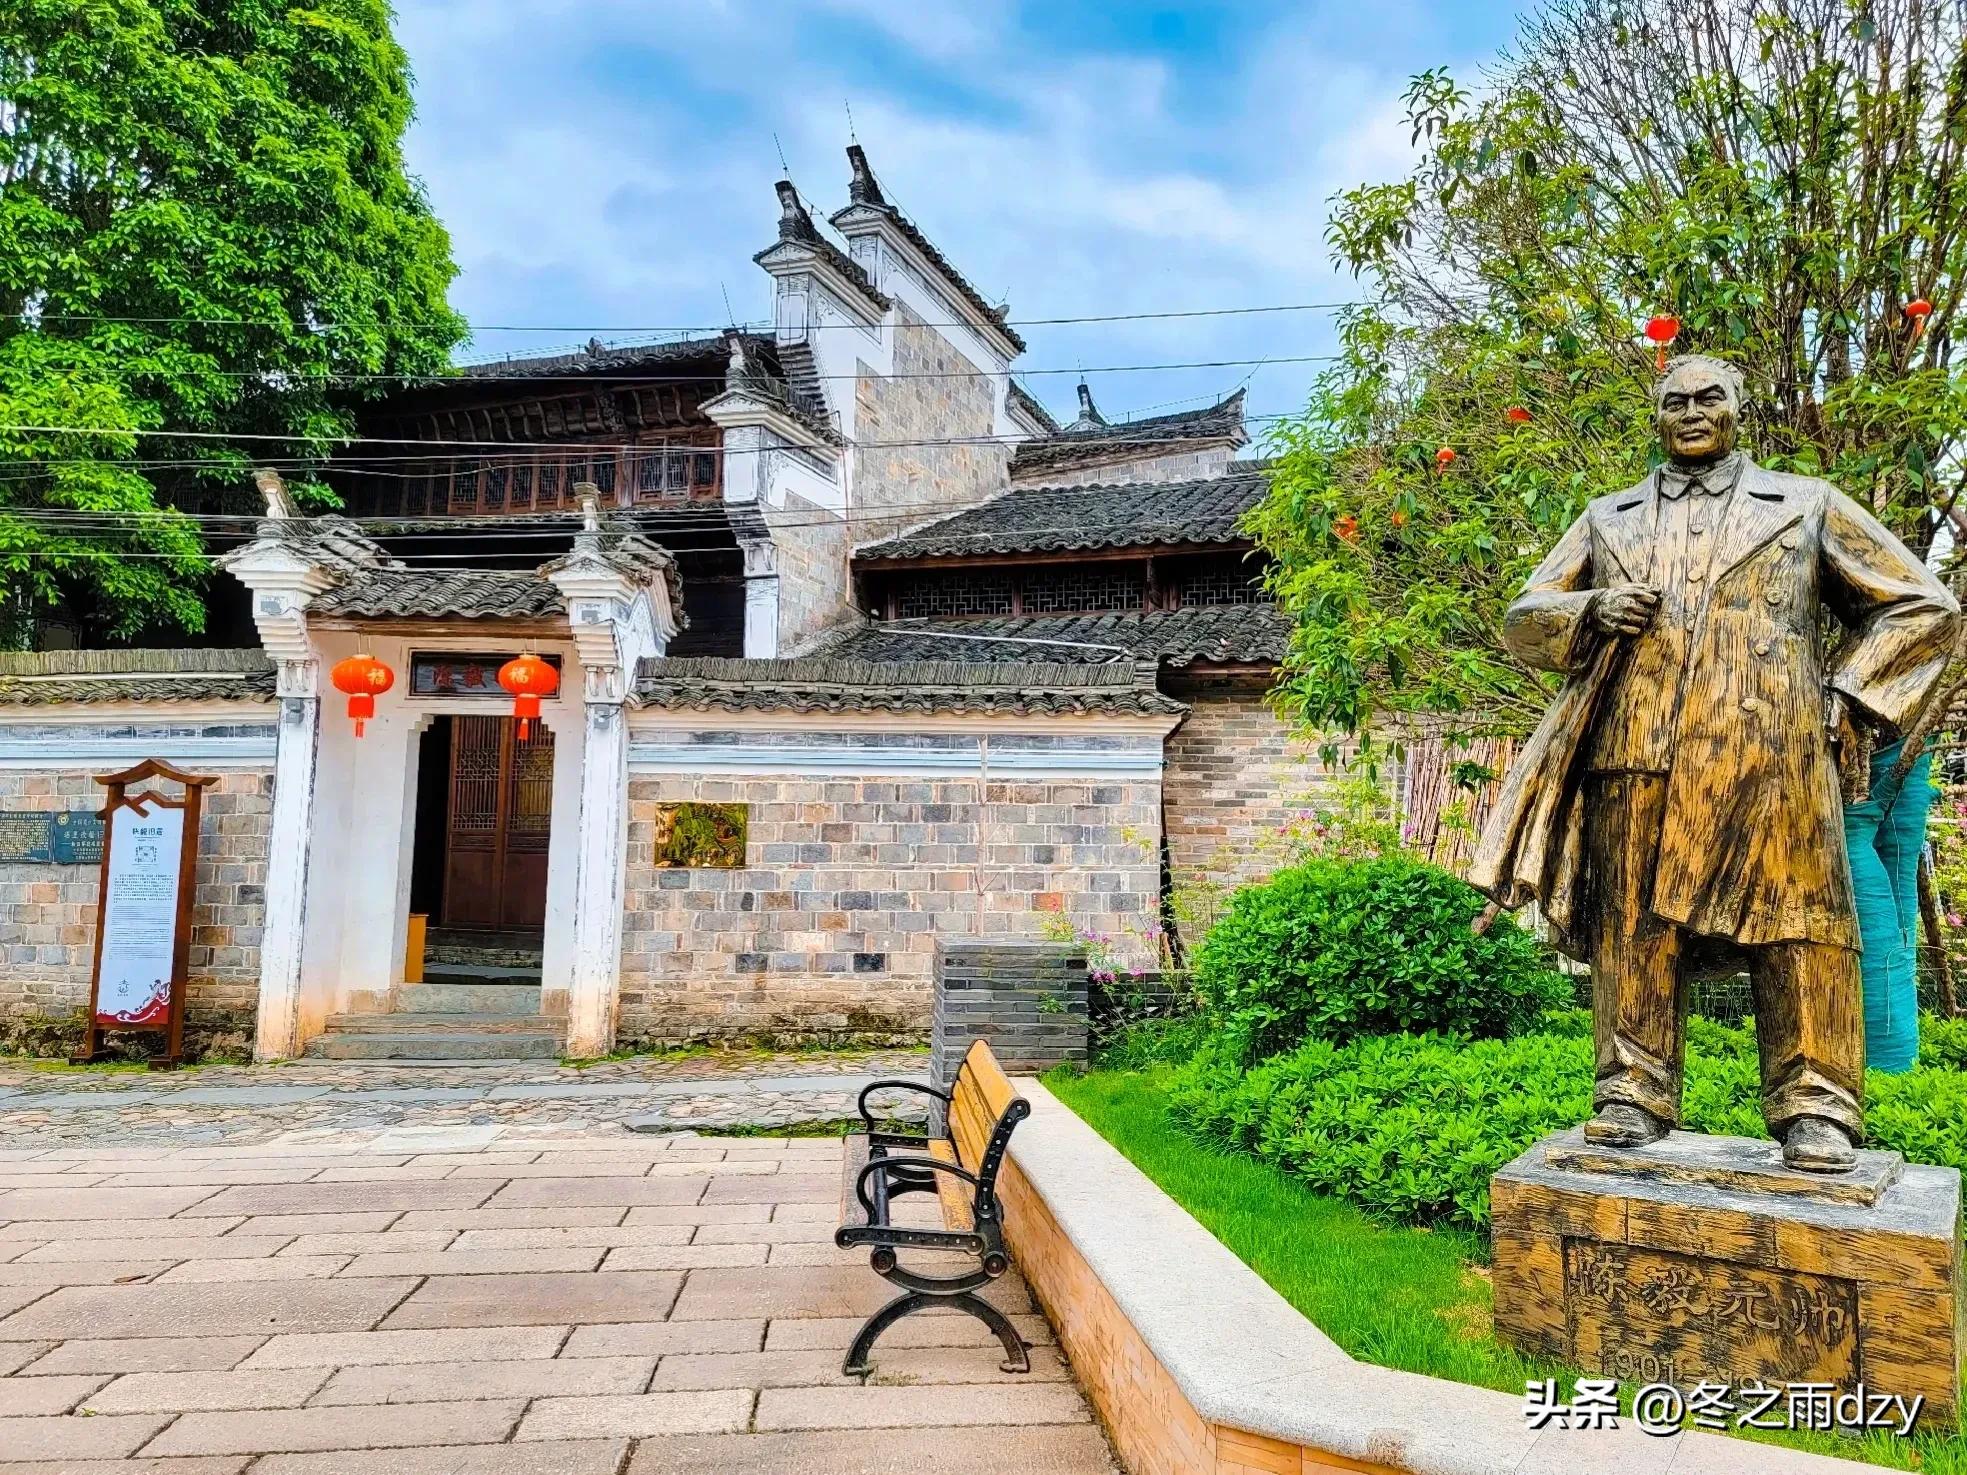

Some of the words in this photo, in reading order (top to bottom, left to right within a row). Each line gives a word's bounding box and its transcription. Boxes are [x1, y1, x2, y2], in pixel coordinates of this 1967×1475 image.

[367, 668, 385, 686] 福
[508, 666, 529, 684] 福
[1575, 1253, 1844, 1346] 陈毅元帅
